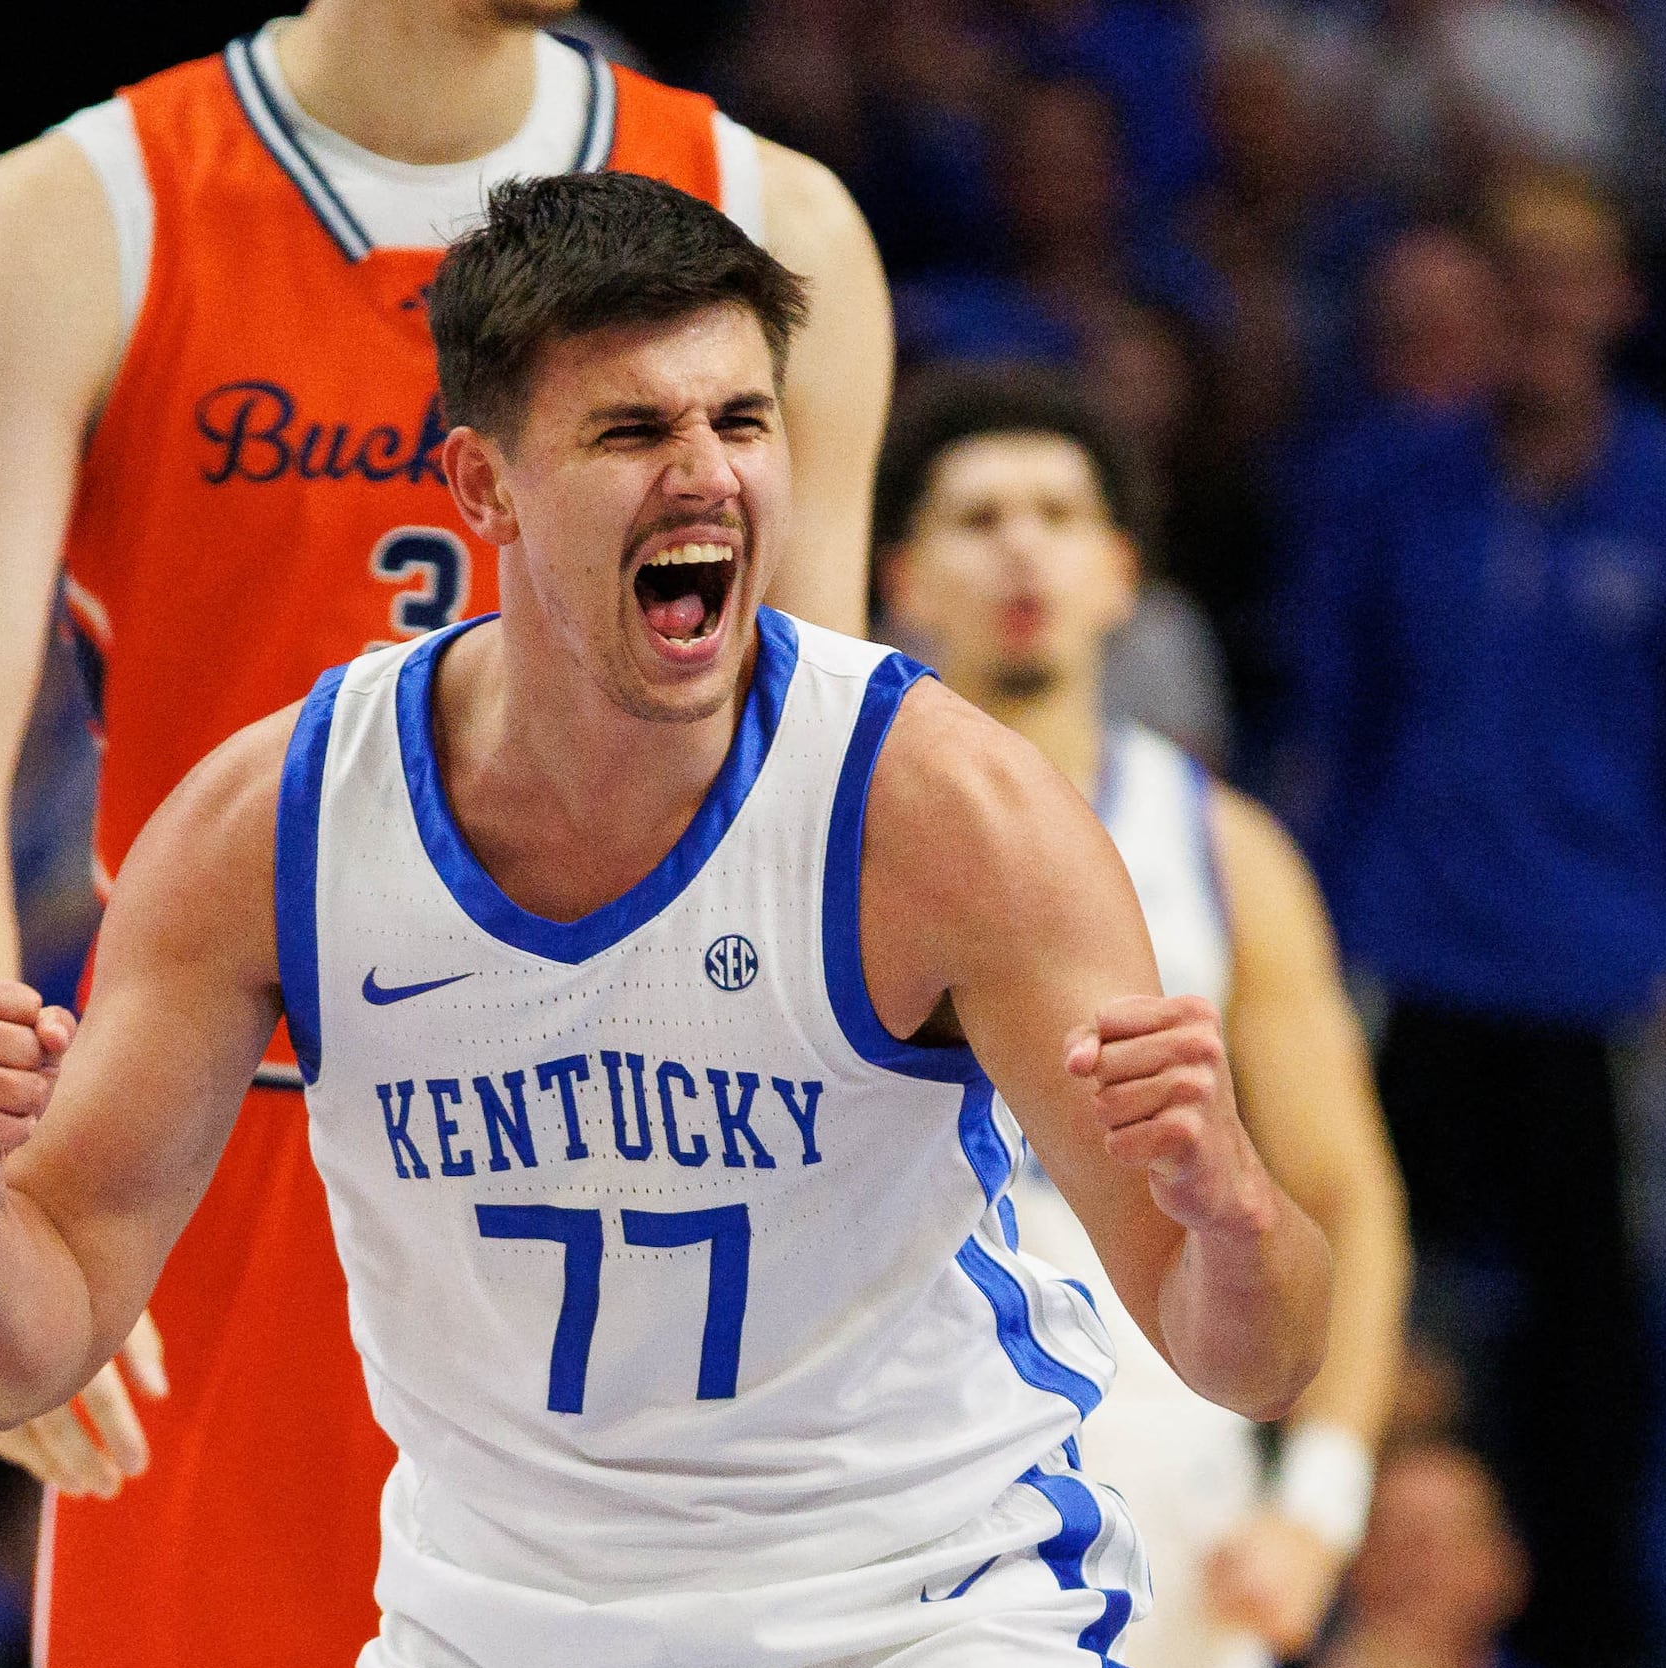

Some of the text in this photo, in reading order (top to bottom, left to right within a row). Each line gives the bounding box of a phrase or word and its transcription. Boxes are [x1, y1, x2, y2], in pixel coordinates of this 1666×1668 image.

[707, 936, 756, 988] SEC
[375, 1050, 824, 1180] KENTUCKY
[474, 1202, 751, 1414] 77
